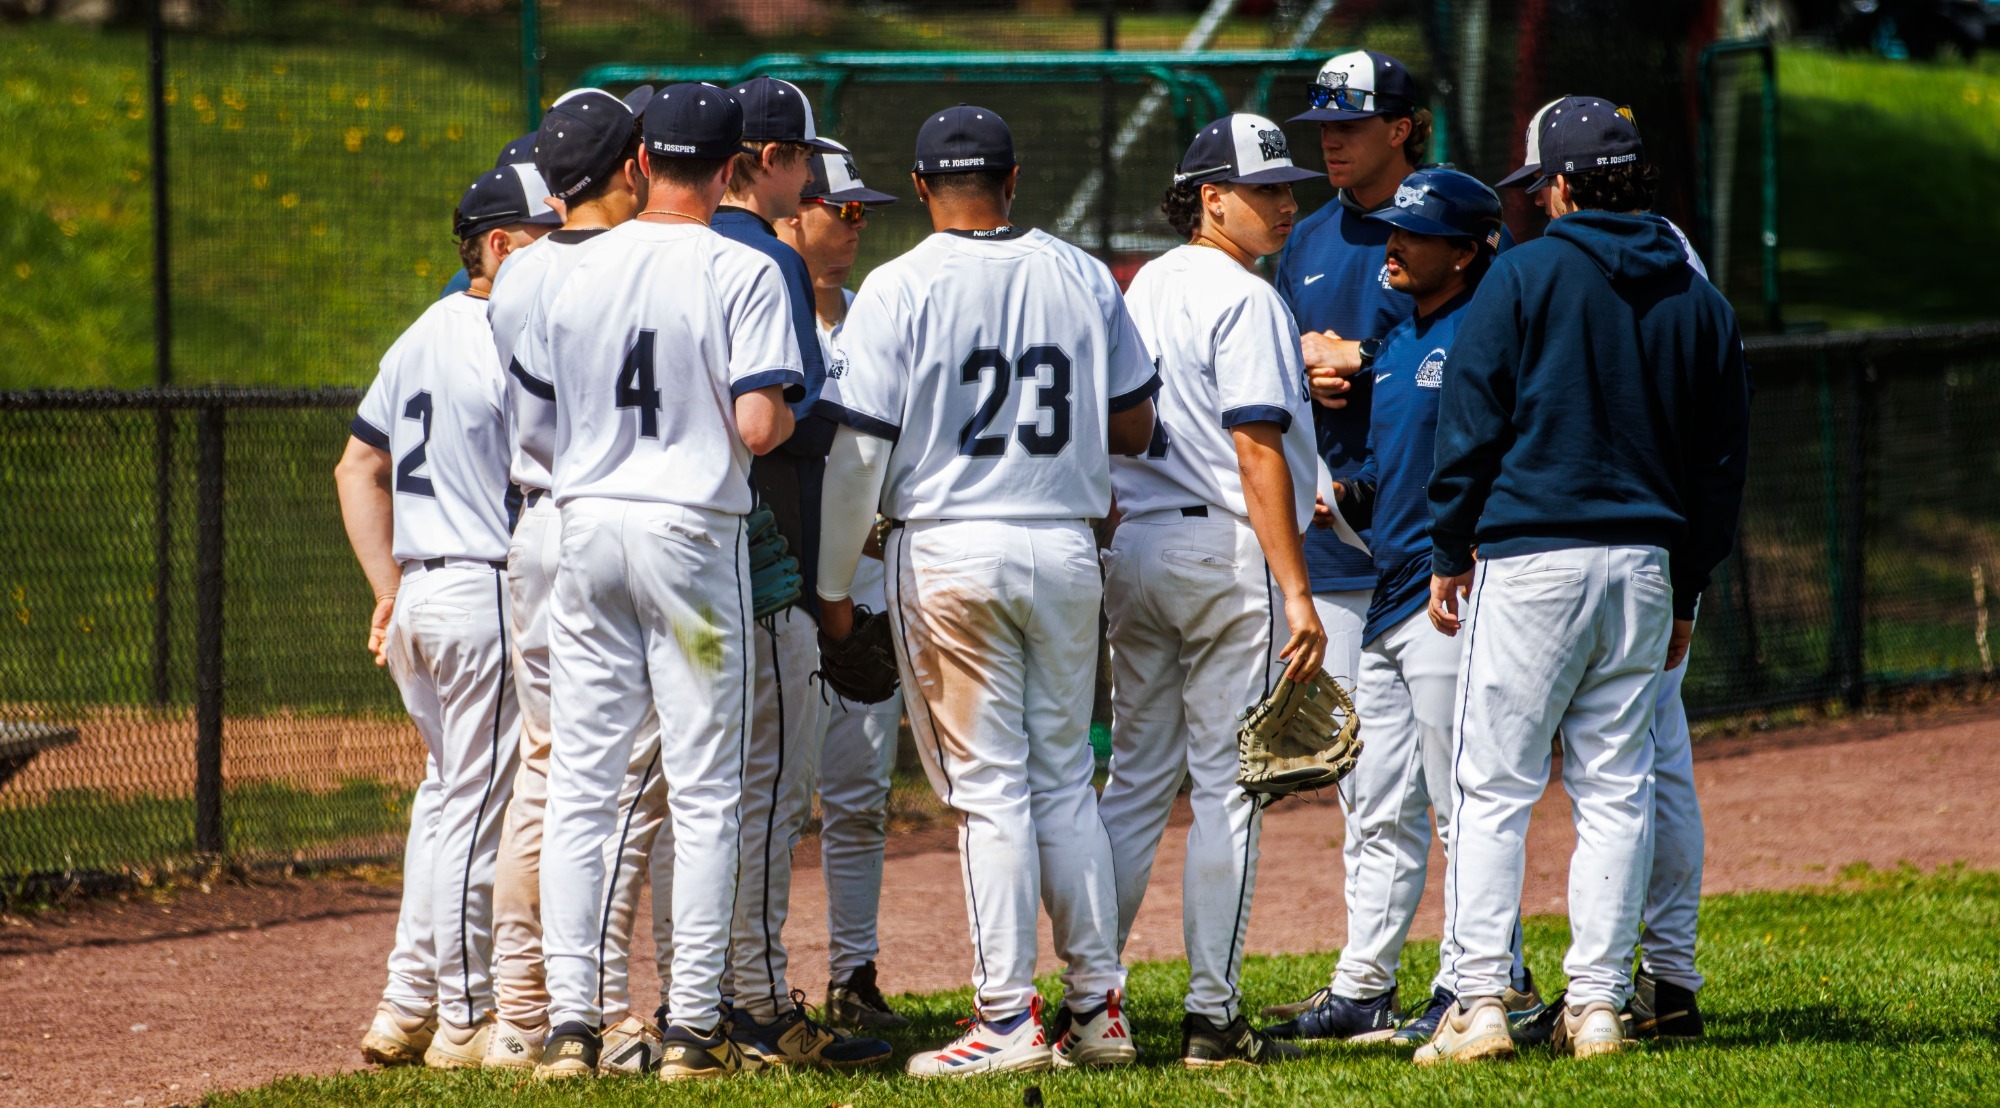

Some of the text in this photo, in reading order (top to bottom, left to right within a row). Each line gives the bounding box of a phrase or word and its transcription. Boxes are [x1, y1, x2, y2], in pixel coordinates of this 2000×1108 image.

[653, 141, 696, 154] ST. JOSEPH'S
[940, 157, 985, 168] ST. JOSEPH'S
[1596, 157, 1609, 165] ST.
[973, 229, 996, 237] NIKE
[615, 328, 662, 440] 4
[958, 343, 1073, 458] 23
[396, 388, 436, 499] 2
